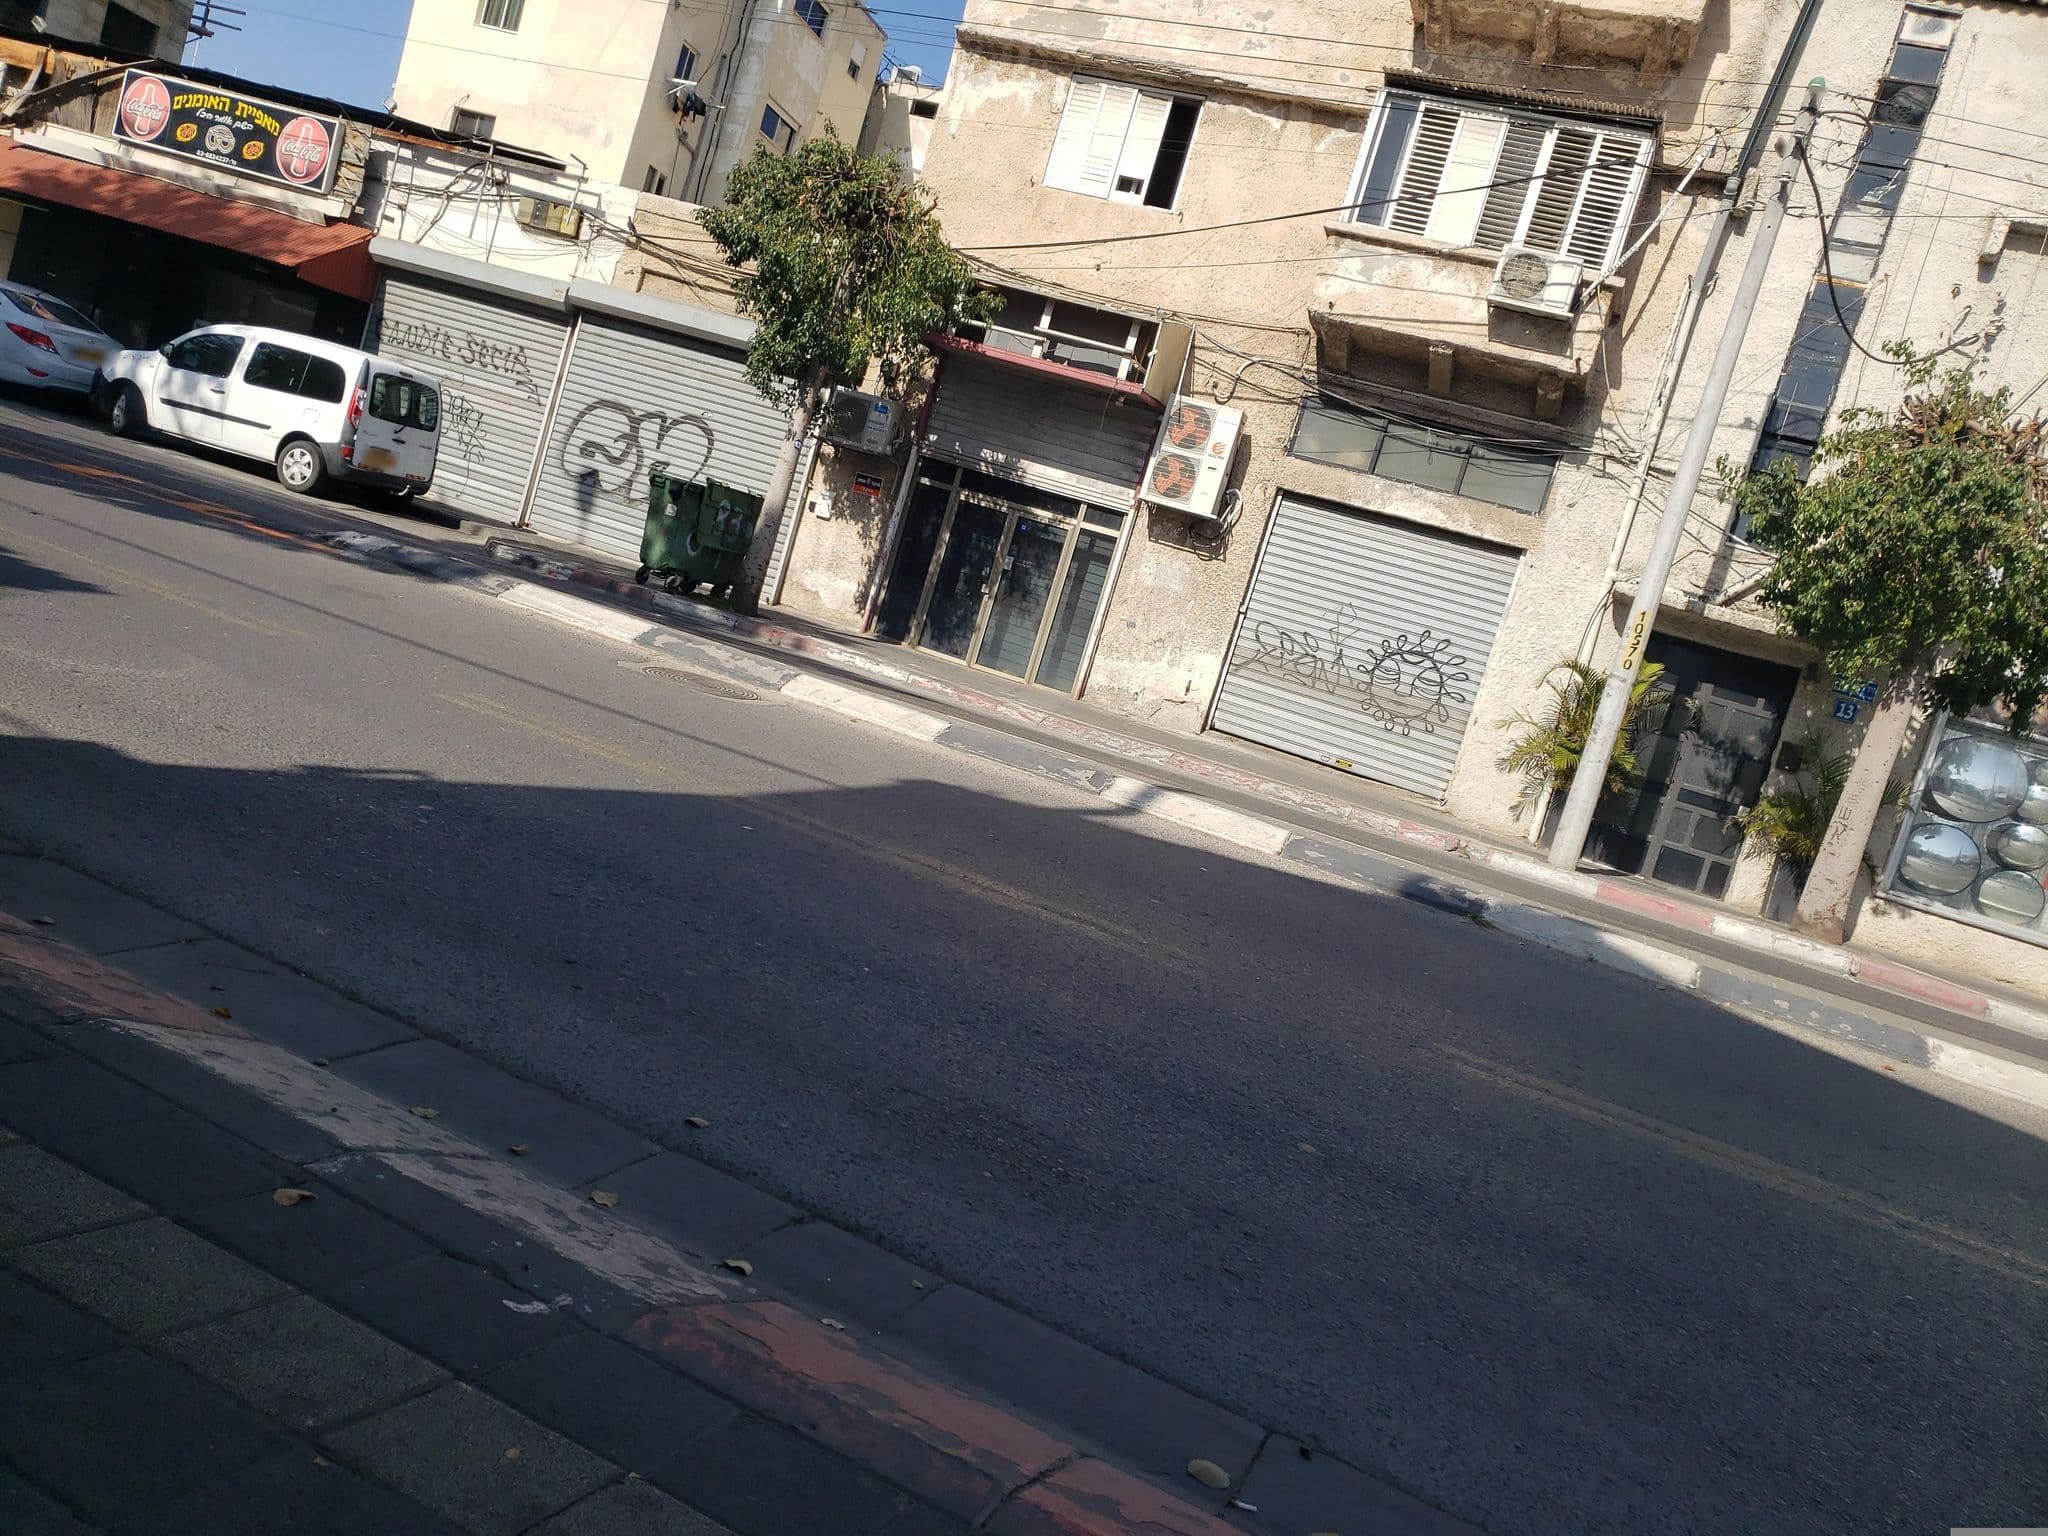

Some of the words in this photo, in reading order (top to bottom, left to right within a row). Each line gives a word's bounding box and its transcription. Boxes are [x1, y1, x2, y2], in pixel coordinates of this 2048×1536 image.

[173, 93, 230, 111] האומנים
[236, 101, 280, 136] מאפיית
[1624, 612, 1646, 669] 10570
[1836, 703, 1854, 719] 13
